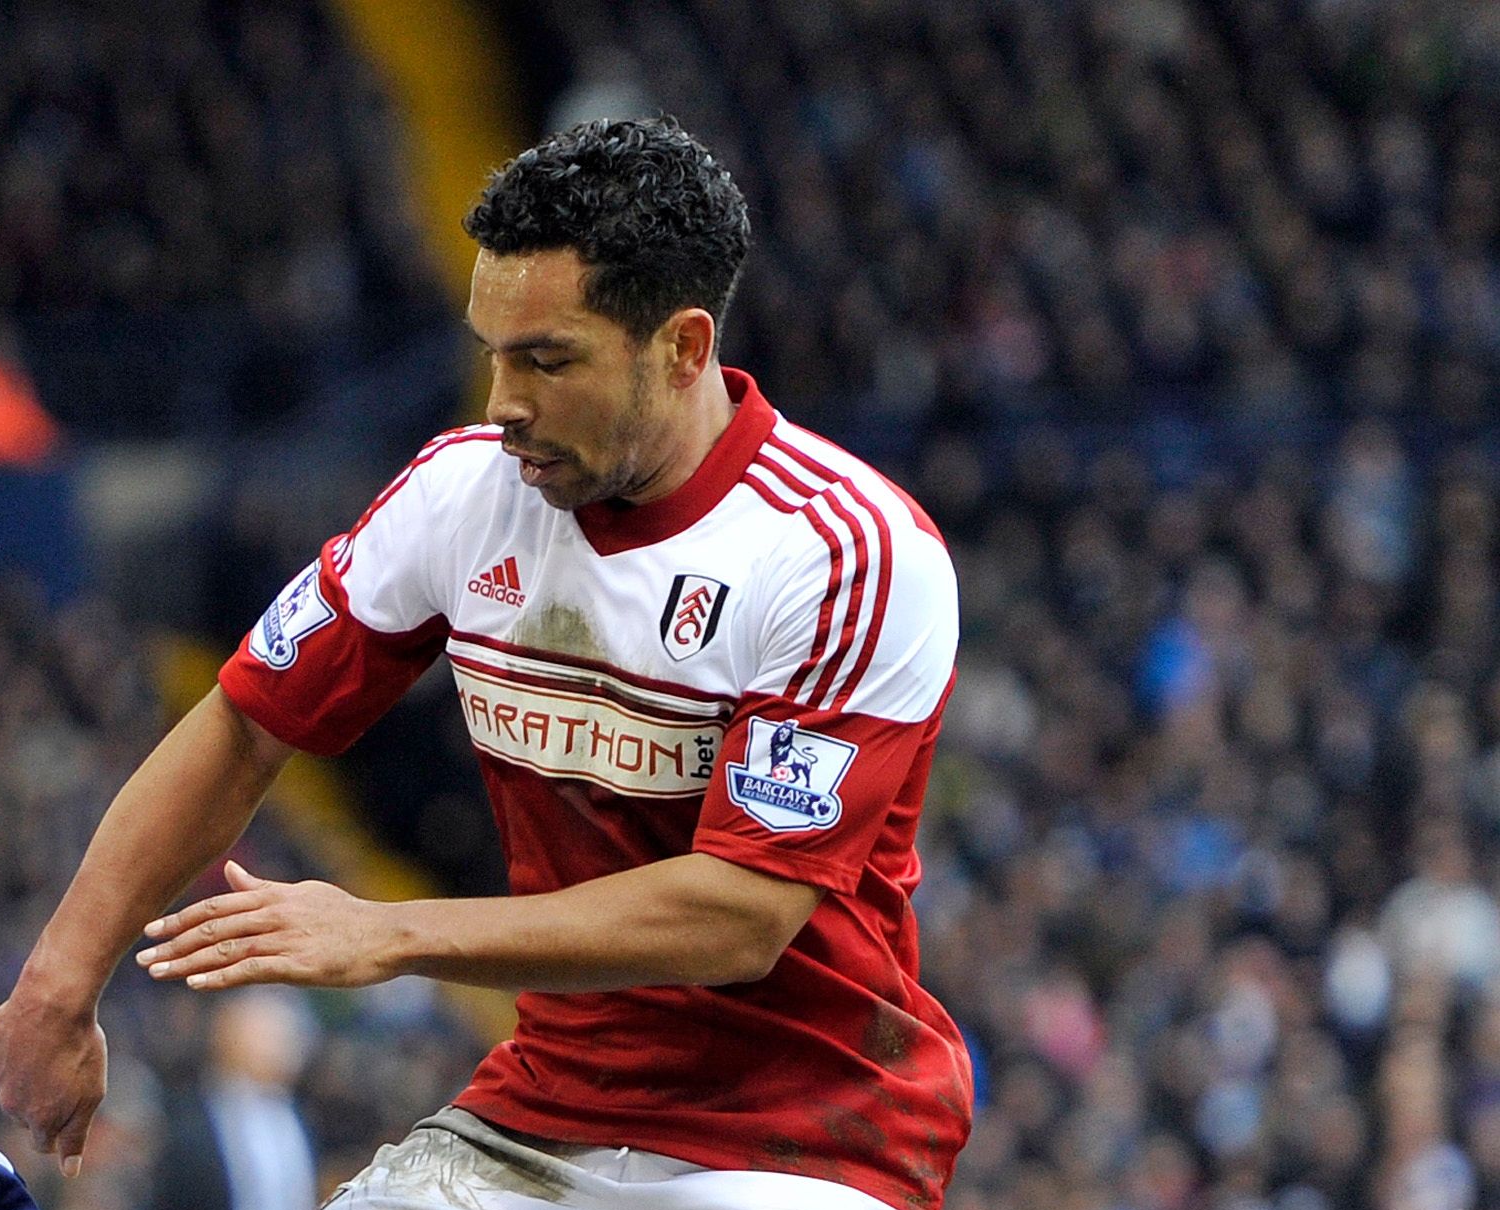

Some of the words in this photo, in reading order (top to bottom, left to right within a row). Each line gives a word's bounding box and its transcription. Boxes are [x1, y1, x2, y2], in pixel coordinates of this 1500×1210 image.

[467, 579, 526, 609] adidas
[674, 585, 712, 645] FFC
[690, 735, 715, 779] bet
[742, 776, 812, 806] BARCLAYS
